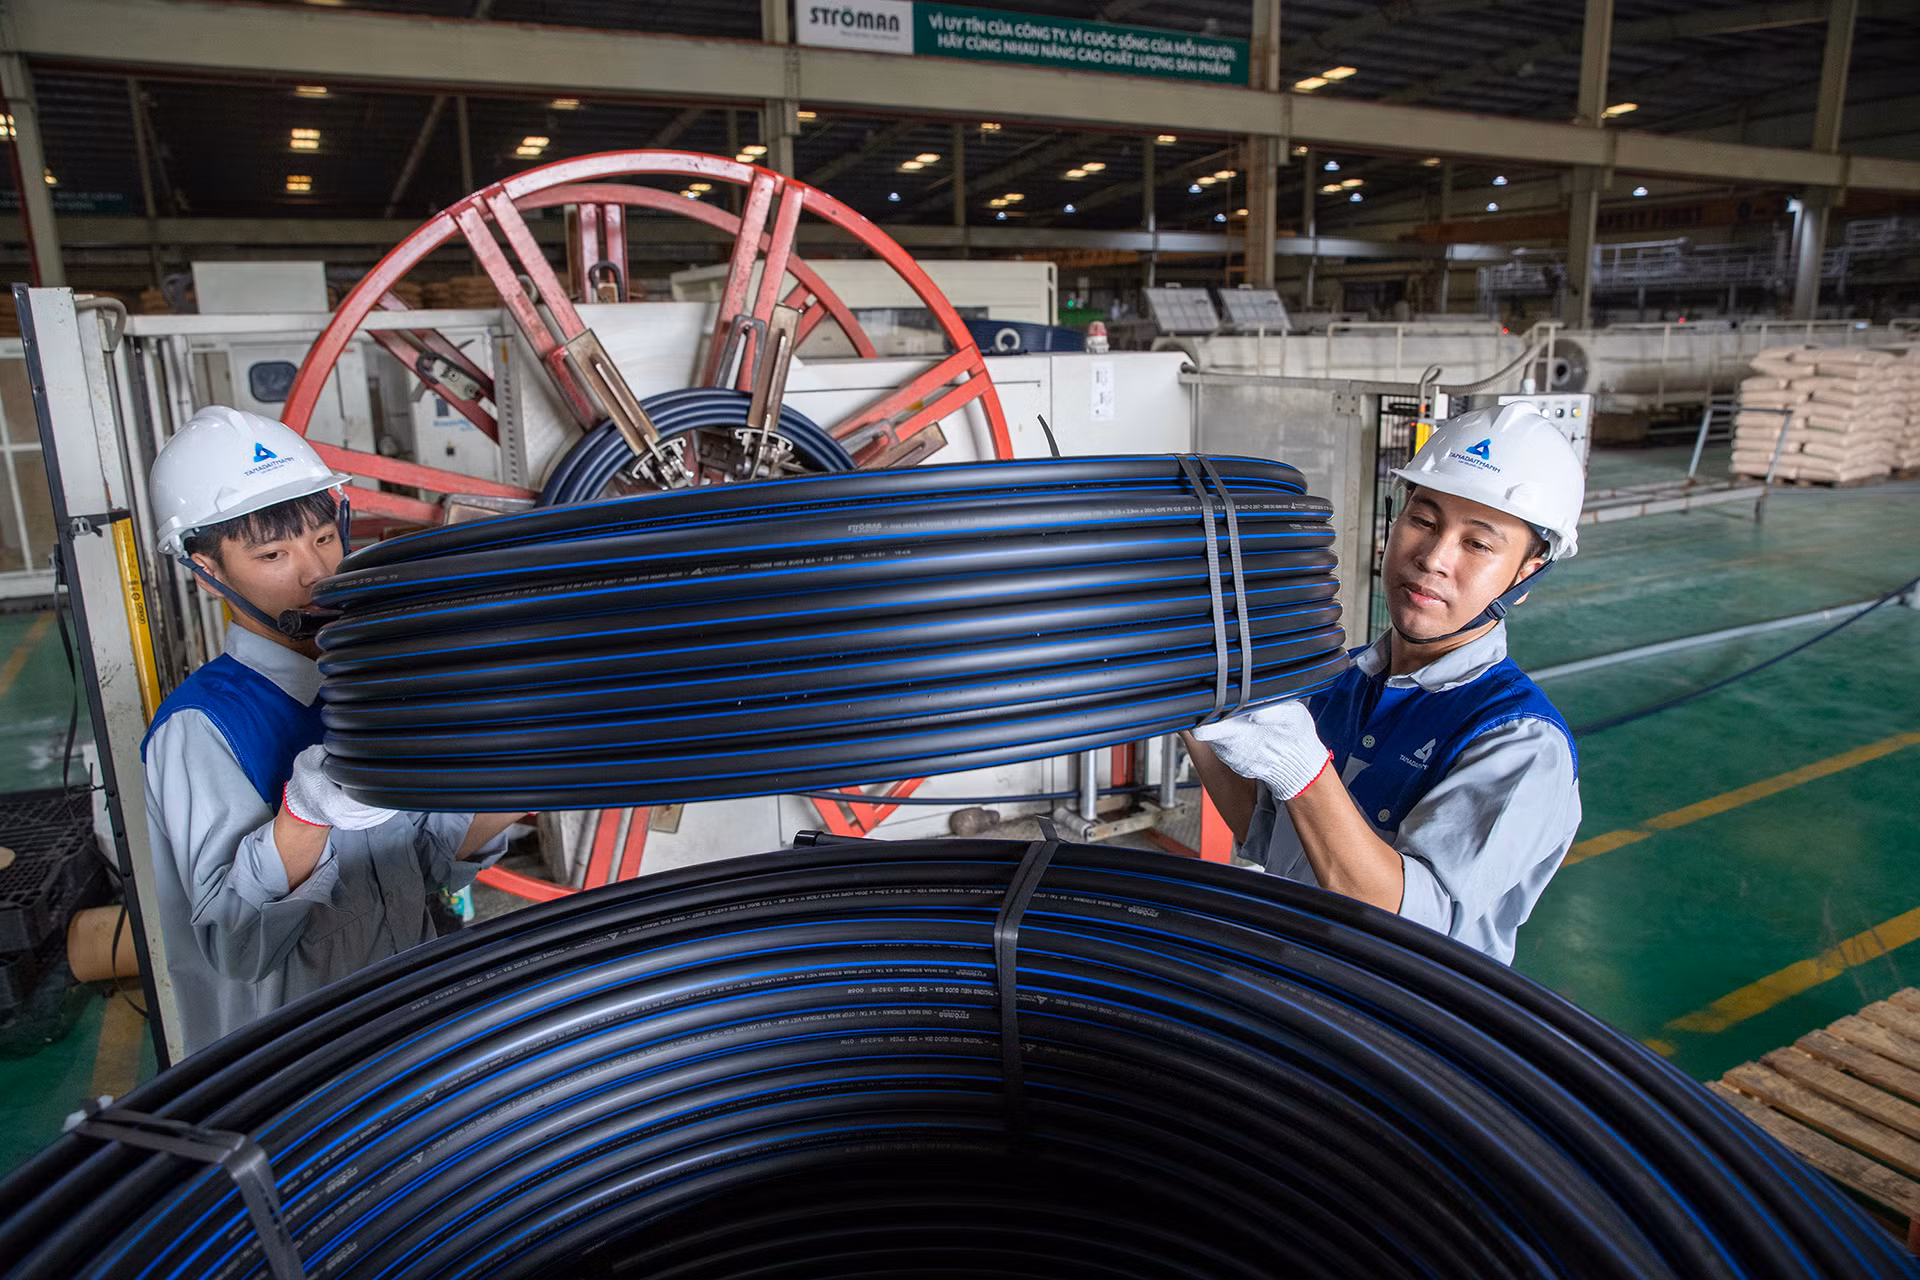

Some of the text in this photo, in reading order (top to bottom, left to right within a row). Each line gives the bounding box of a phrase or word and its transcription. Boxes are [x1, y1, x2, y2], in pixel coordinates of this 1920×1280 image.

[809, 7, 900, 33] STRÖMAN
[928, 13, 944, 29] VÌ
[944, 15, 964, 32] UY
[964, 16, 986, 34] TÍN
[987, 18, 1014, 36] CỦA
[1015, 21, 1050, 41] CÔNG
[1069, 26, 1083, 44] VÌ
[1083, 30, 1117, 49] CUỘC
[1117, 30, 1150, 52] SỐNG
[1150, 37, 1174, 54] CỦA
[1175, 39, 1196, 57] MỖI
[937, 32, 965, 49] HÃY
[965, 34, 1001, 53] CÙNG
[1003, 39, 1040, 57] NHAU
[1041, 42, 1076, 60] NÂNG
[1077, 46, 1102, 63] CAO
[1103, 48, 1134, 66] CHẤT
[1135, 52, 1175, 71] LƯỢNG
[817, 969, 842, 977] STROMAN
[802, 1013, 826, 1021] STROMAN
